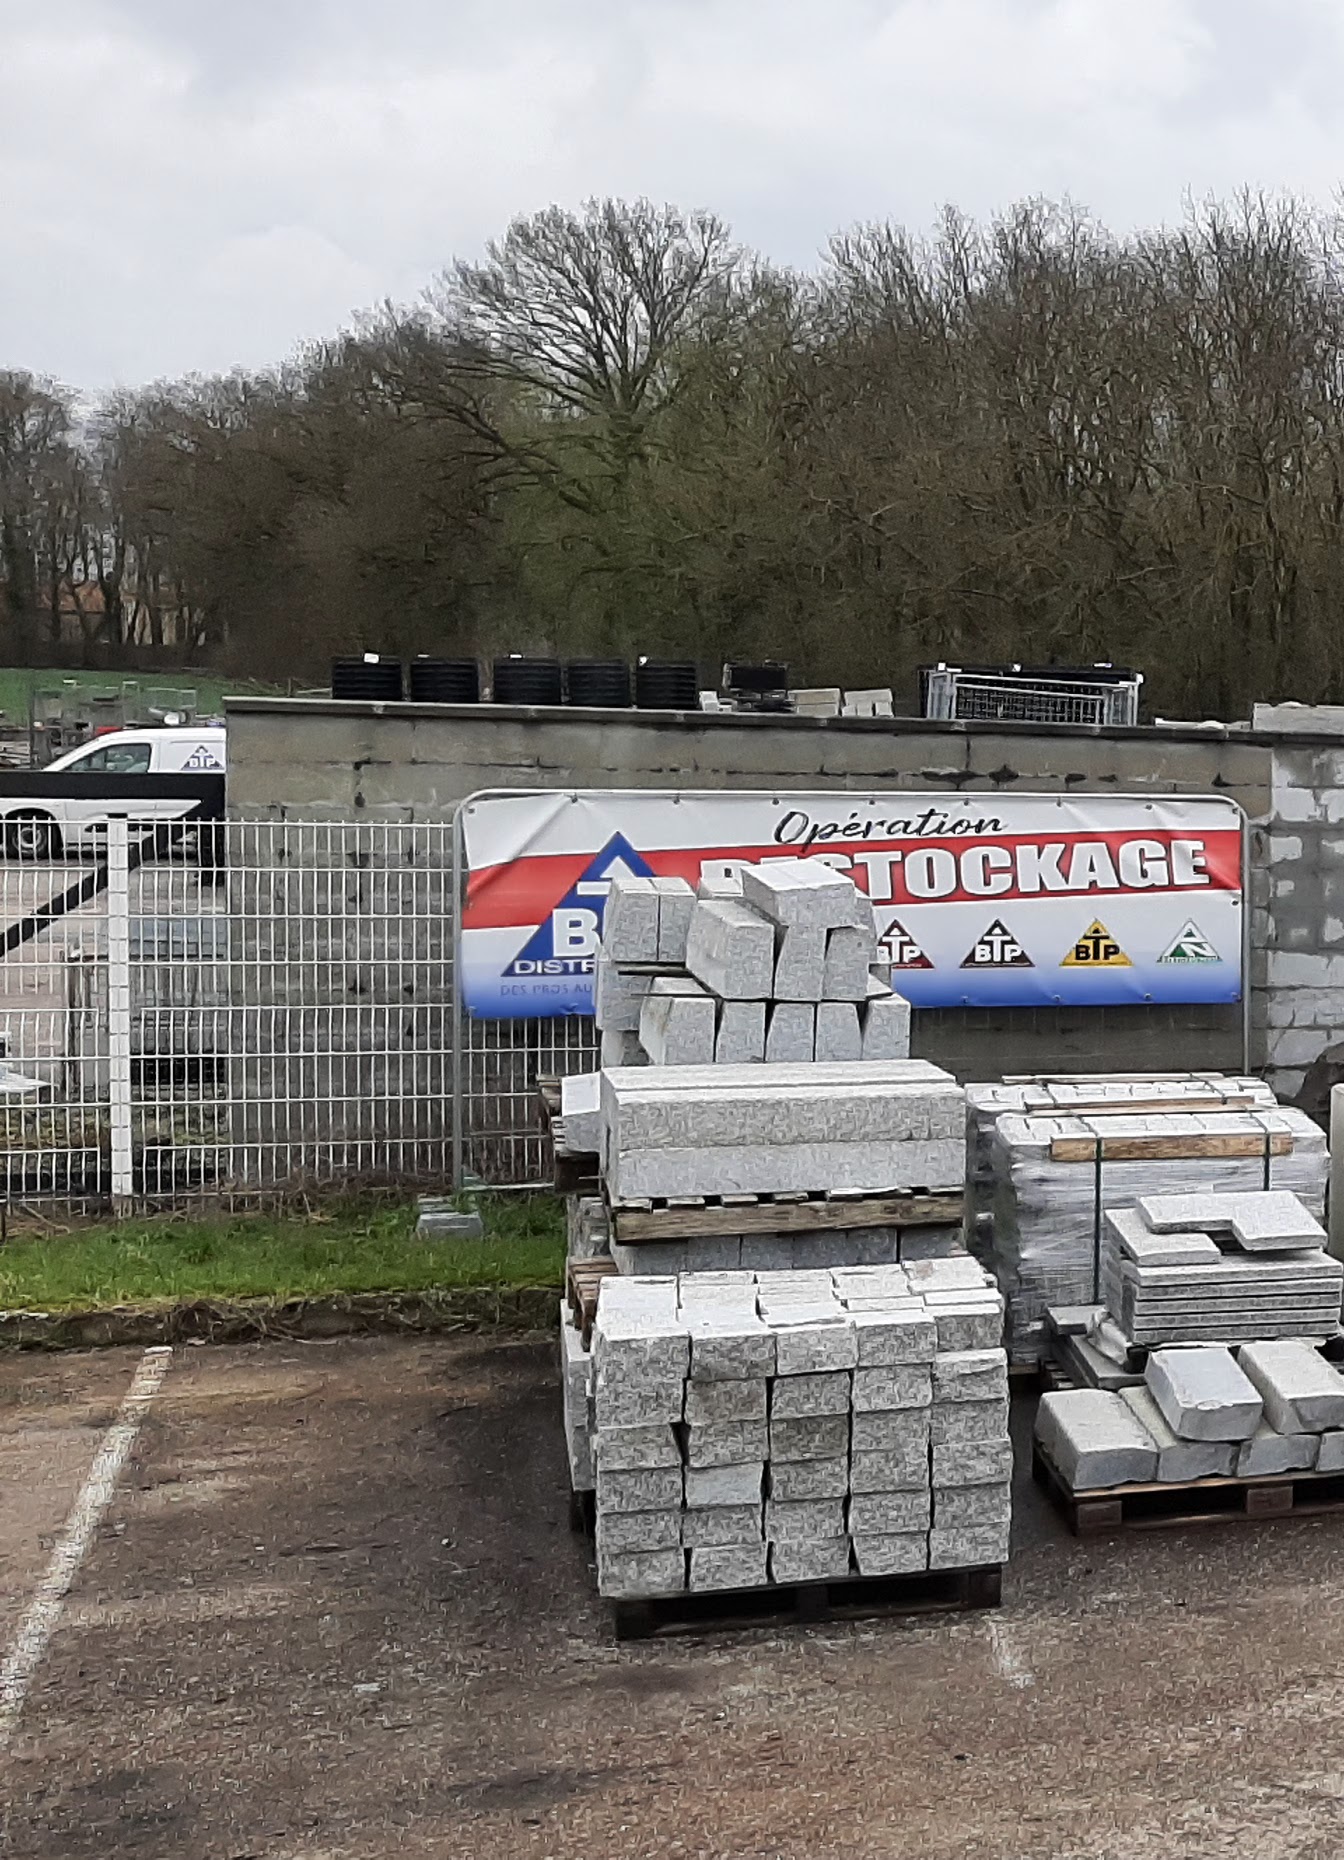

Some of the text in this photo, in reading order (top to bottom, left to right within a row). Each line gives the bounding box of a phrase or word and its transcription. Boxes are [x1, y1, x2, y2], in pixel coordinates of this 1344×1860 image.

[773, 808, 1003, 853] Opération
[974, 935, 1023, 962] BTP
[1075, 935, 1120, 961] BTP
